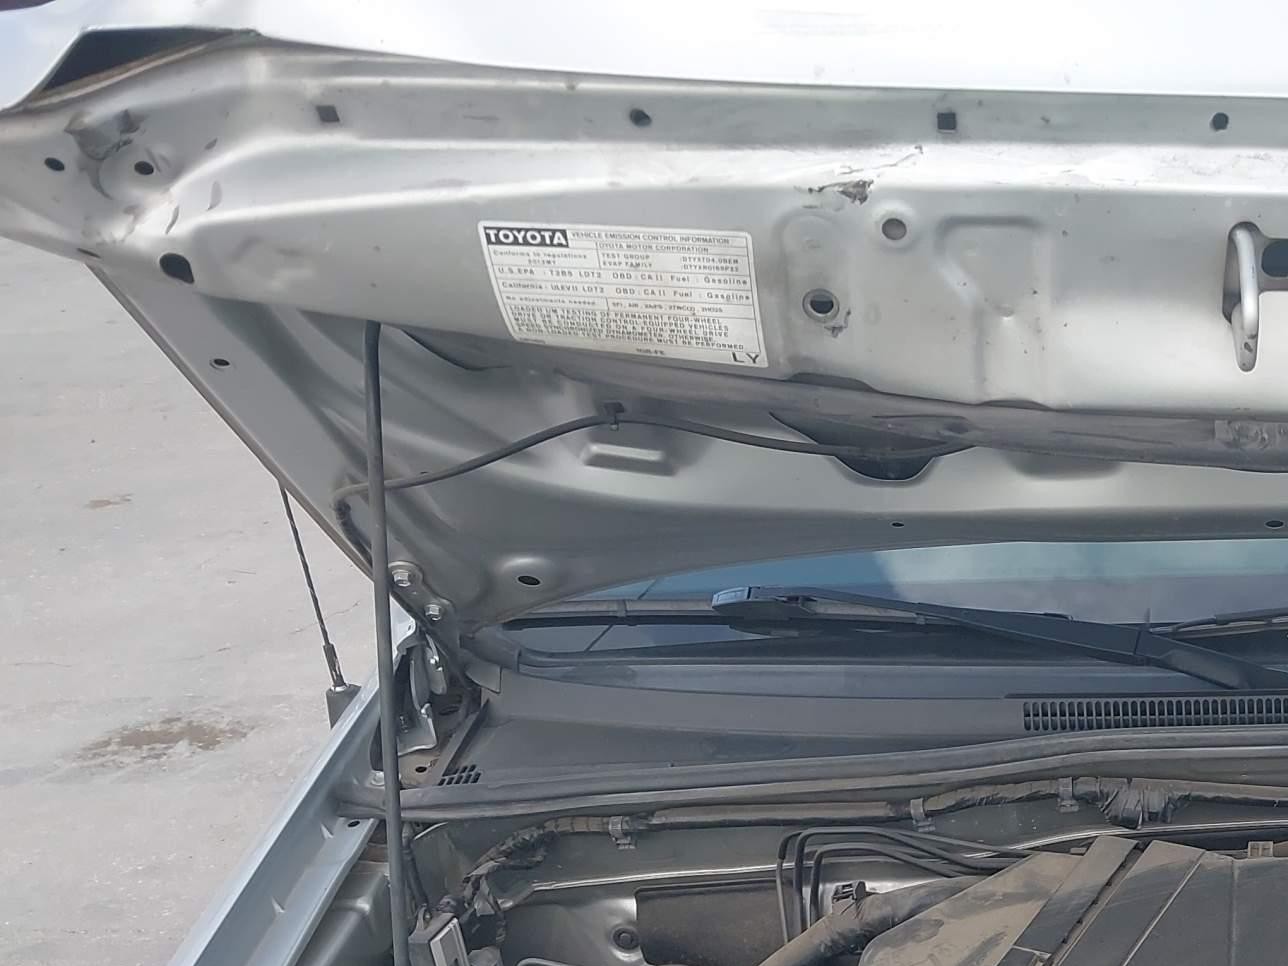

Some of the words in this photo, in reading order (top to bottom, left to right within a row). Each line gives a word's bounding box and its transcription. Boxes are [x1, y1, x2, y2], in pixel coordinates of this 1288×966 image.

[485, 229, 567, 246] TOYOTA
[571, 231, 603, 240] VEHICLE
[605, 232, 641, 241] EMISSION
[642, 234, 676, 243] CONTROL
[679, 235, 730, 245] INFORMATION
[670, 274, 690, 282] Fuel
[703, 276, 748, 286] Gasoline
[706, 292, 750, 301] Gasoline
[732, 351, 759, 364] LY
